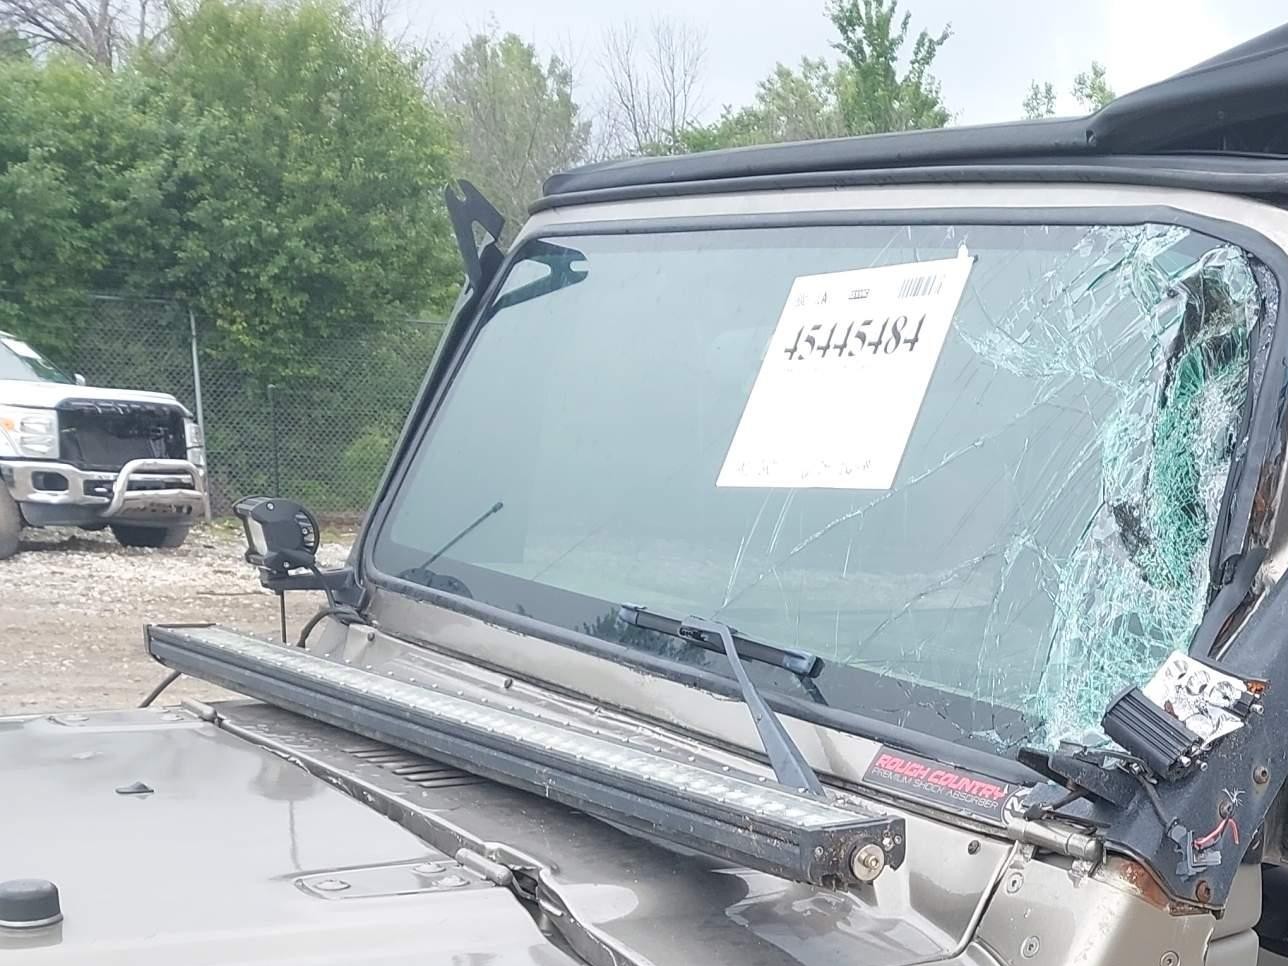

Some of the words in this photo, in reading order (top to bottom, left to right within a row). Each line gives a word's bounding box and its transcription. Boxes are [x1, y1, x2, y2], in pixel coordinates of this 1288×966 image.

[784, 313, 926, 361] 45445484
[871, 767, 912, 785] PREMIUM
[912, 778, 944, 794] SHOCK
[946, 790, 998, 809] ABSORBER
[875, 754, 931, 780] ROUGH
[928, 770, 1006, 800] COUNTRY
